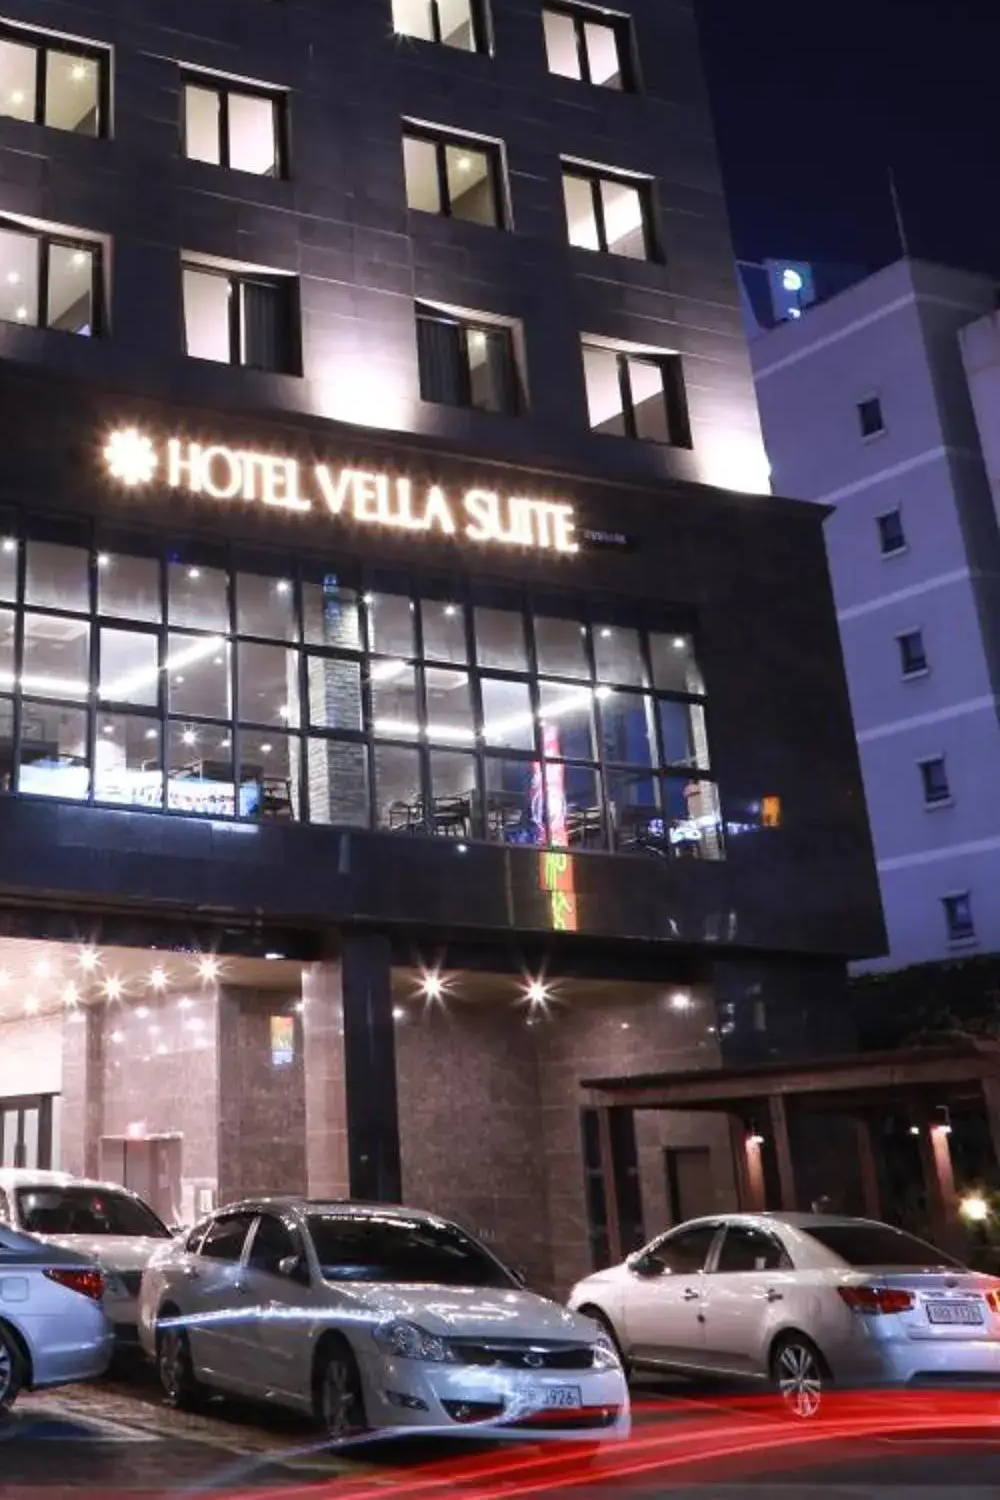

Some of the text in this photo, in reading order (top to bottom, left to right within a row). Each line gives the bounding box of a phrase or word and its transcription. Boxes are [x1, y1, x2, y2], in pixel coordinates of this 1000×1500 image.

[167, 437, 580, 554] HOTEL VELLA SUITE
